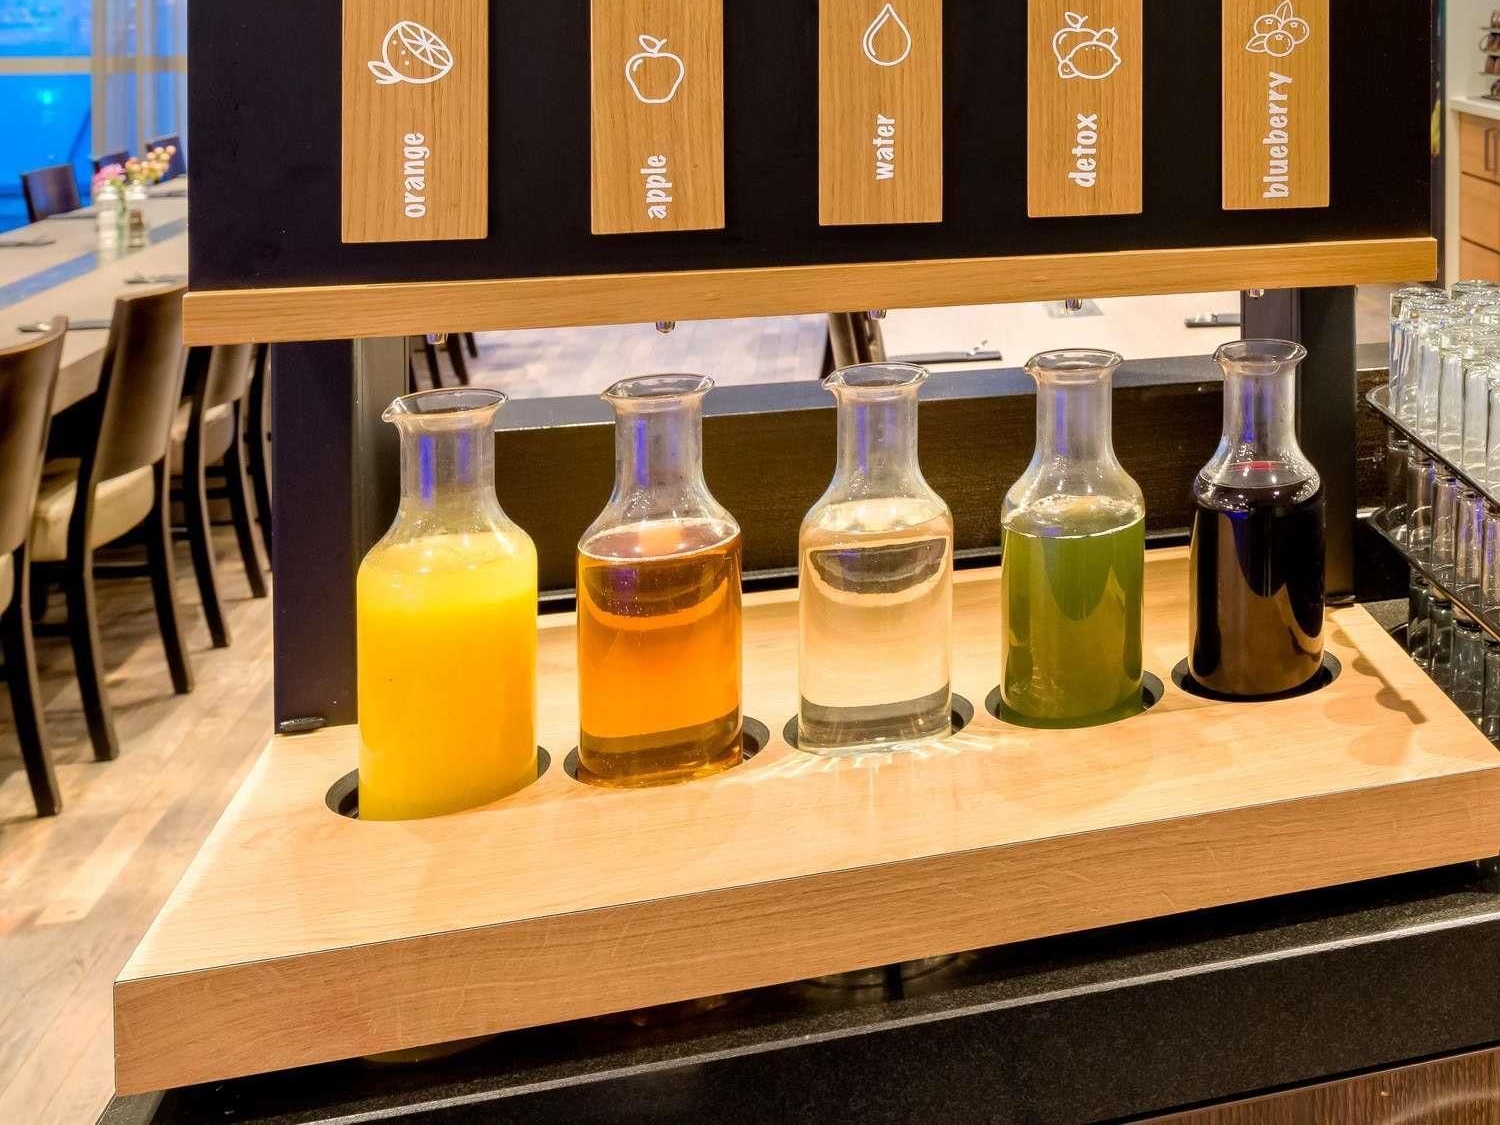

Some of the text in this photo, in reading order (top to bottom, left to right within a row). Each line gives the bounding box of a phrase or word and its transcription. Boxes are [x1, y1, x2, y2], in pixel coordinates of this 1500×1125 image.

[872, 112, 896, 181] water
[1068, 112, 1098, 188] detox
[1262, 71, 1293, 199] blueberry
[402, 131, 430, 219] orange
[639, 154, 673, 220] apple
